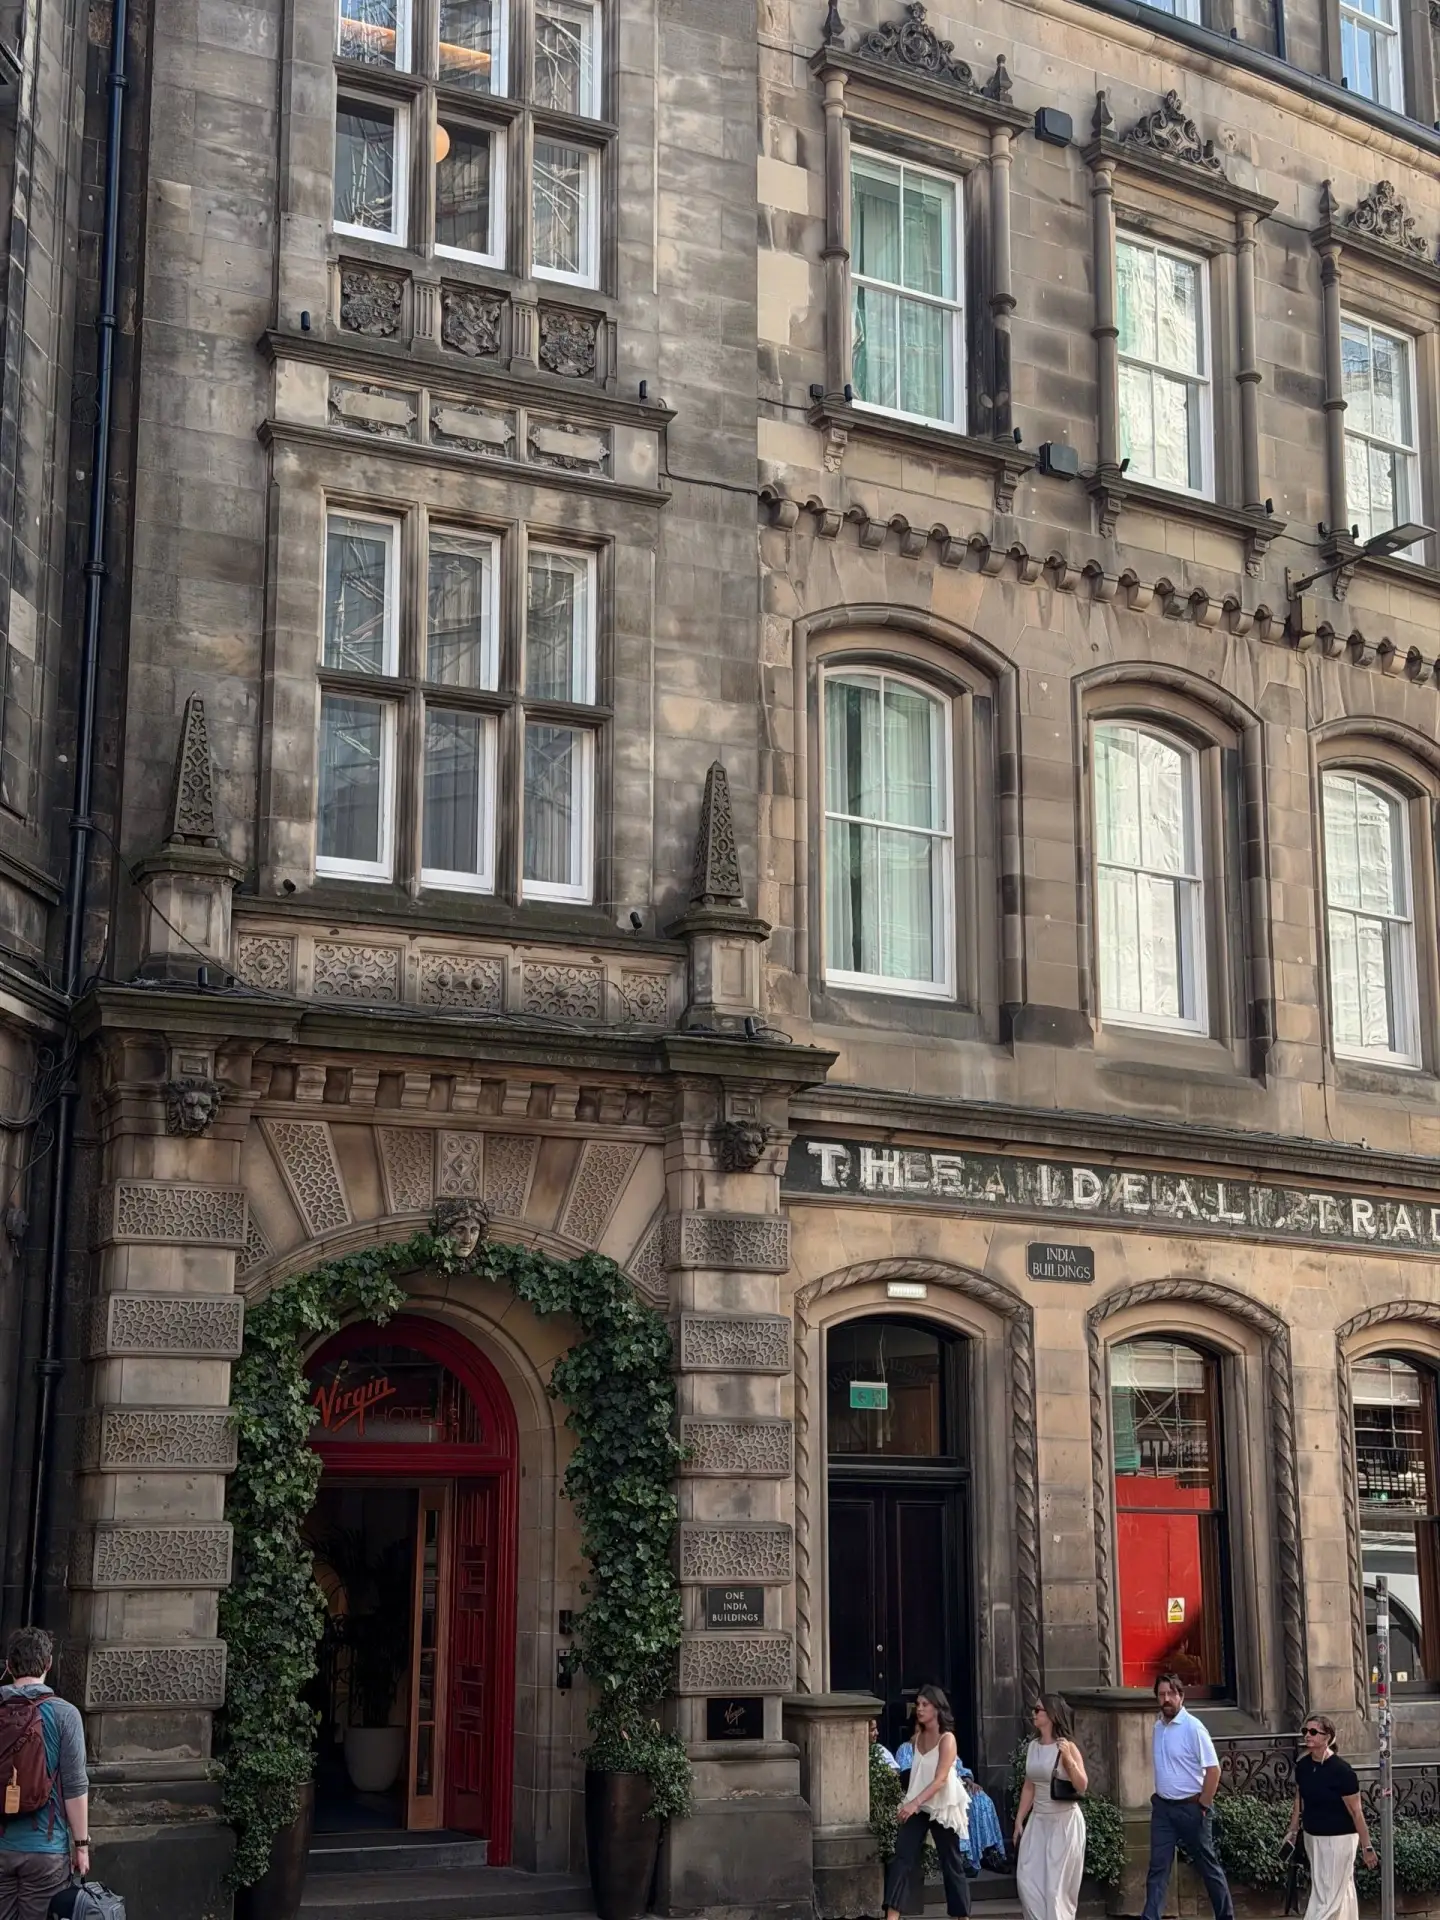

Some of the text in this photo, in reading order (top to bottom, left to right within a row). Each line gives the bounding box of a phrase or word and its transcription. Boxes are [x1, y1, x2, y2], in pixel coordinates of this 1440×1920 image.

[1046, 1247, 1076, 1263] INDIA
[1032, 1261, 1091, 1279] BUILDINGS
[313, 1374, 397, 1436] Virgin
[725, 1591, 745, 1600] ONE
[723, 1602, 748, 1611] INDIA
[712, 1613, 759, 1622] BUILDINGS
